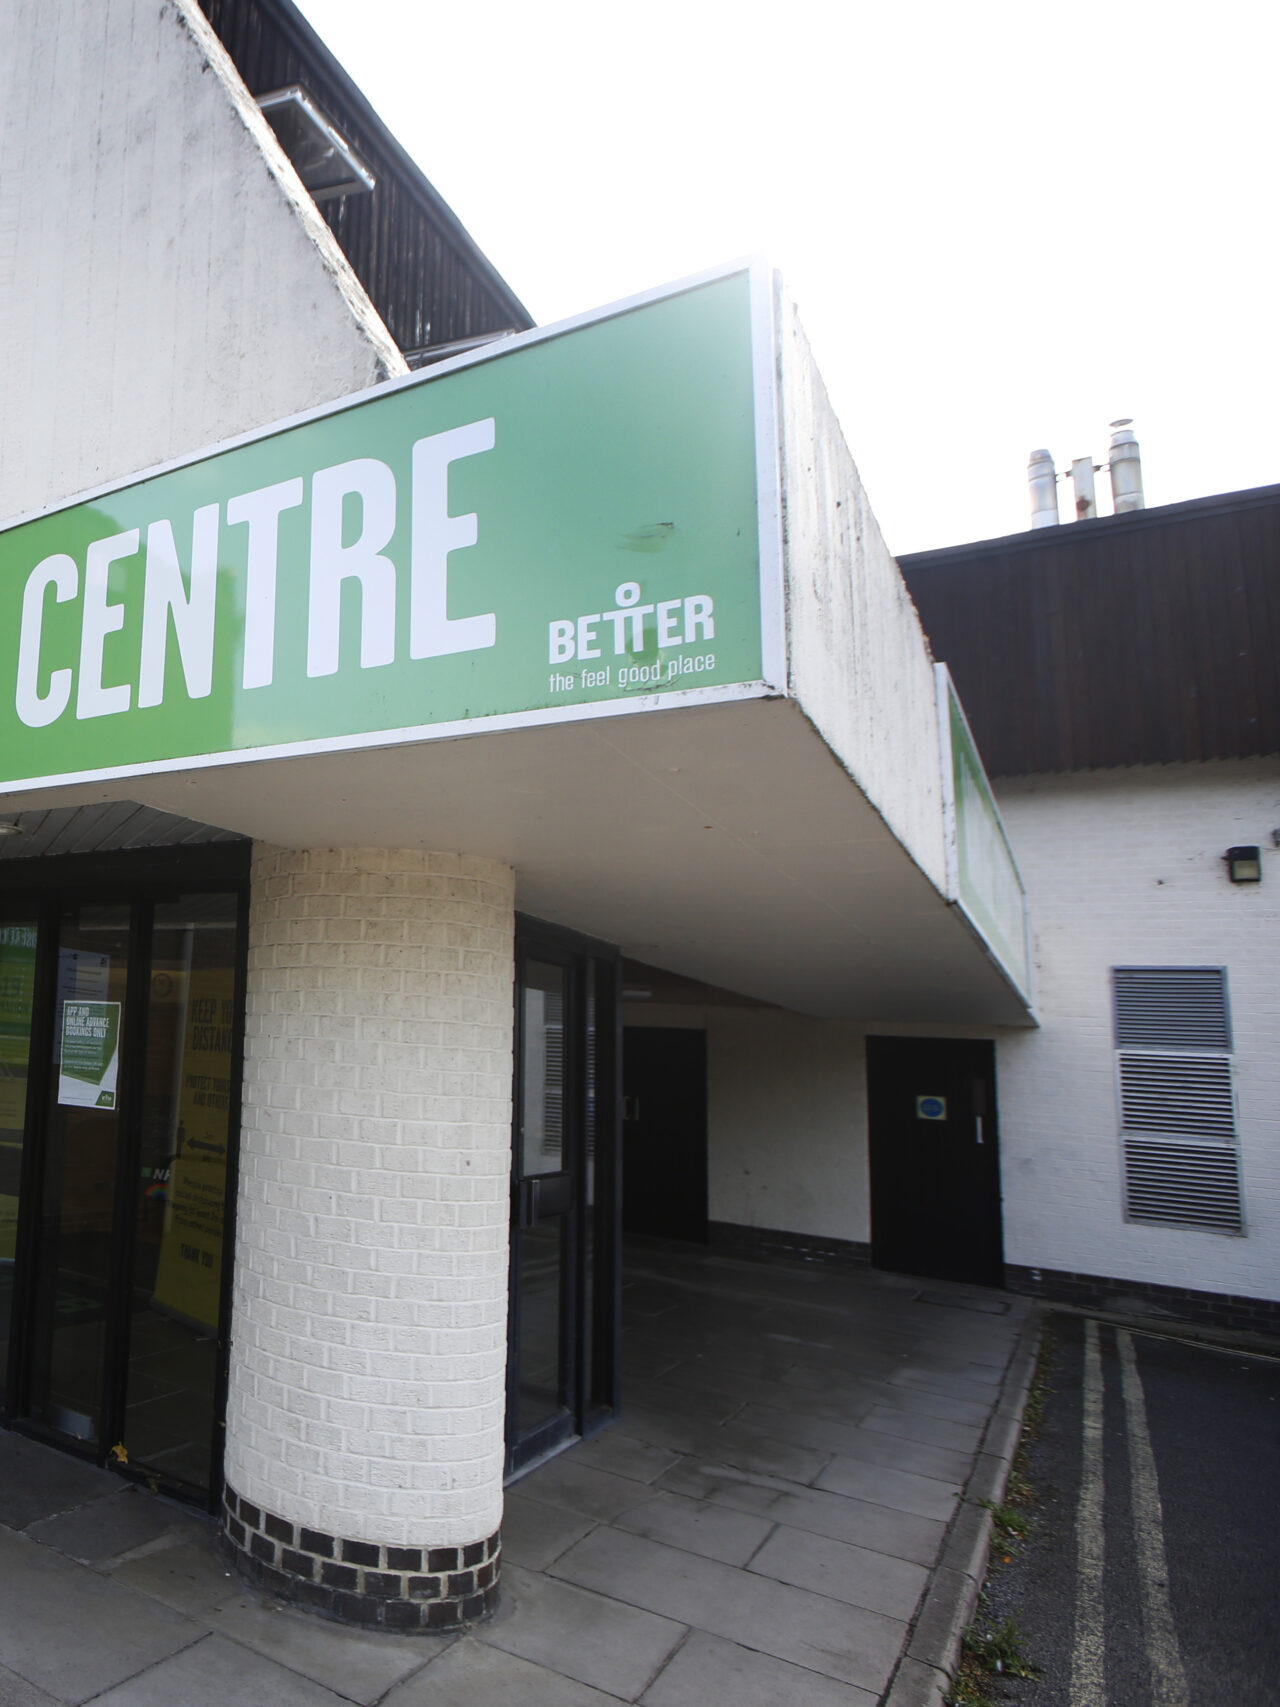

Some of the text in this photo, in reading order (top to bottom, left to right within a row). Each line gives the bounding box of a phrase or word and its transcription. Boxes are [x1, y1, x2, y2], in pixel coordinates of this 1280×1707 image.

[15, 416, 496, 729] CENTRE
[548, 594, 716, 665] BETTER
[549, 653, 716, 693] the feel good place
[86, 1017, 110, 1028] ADVANCE
